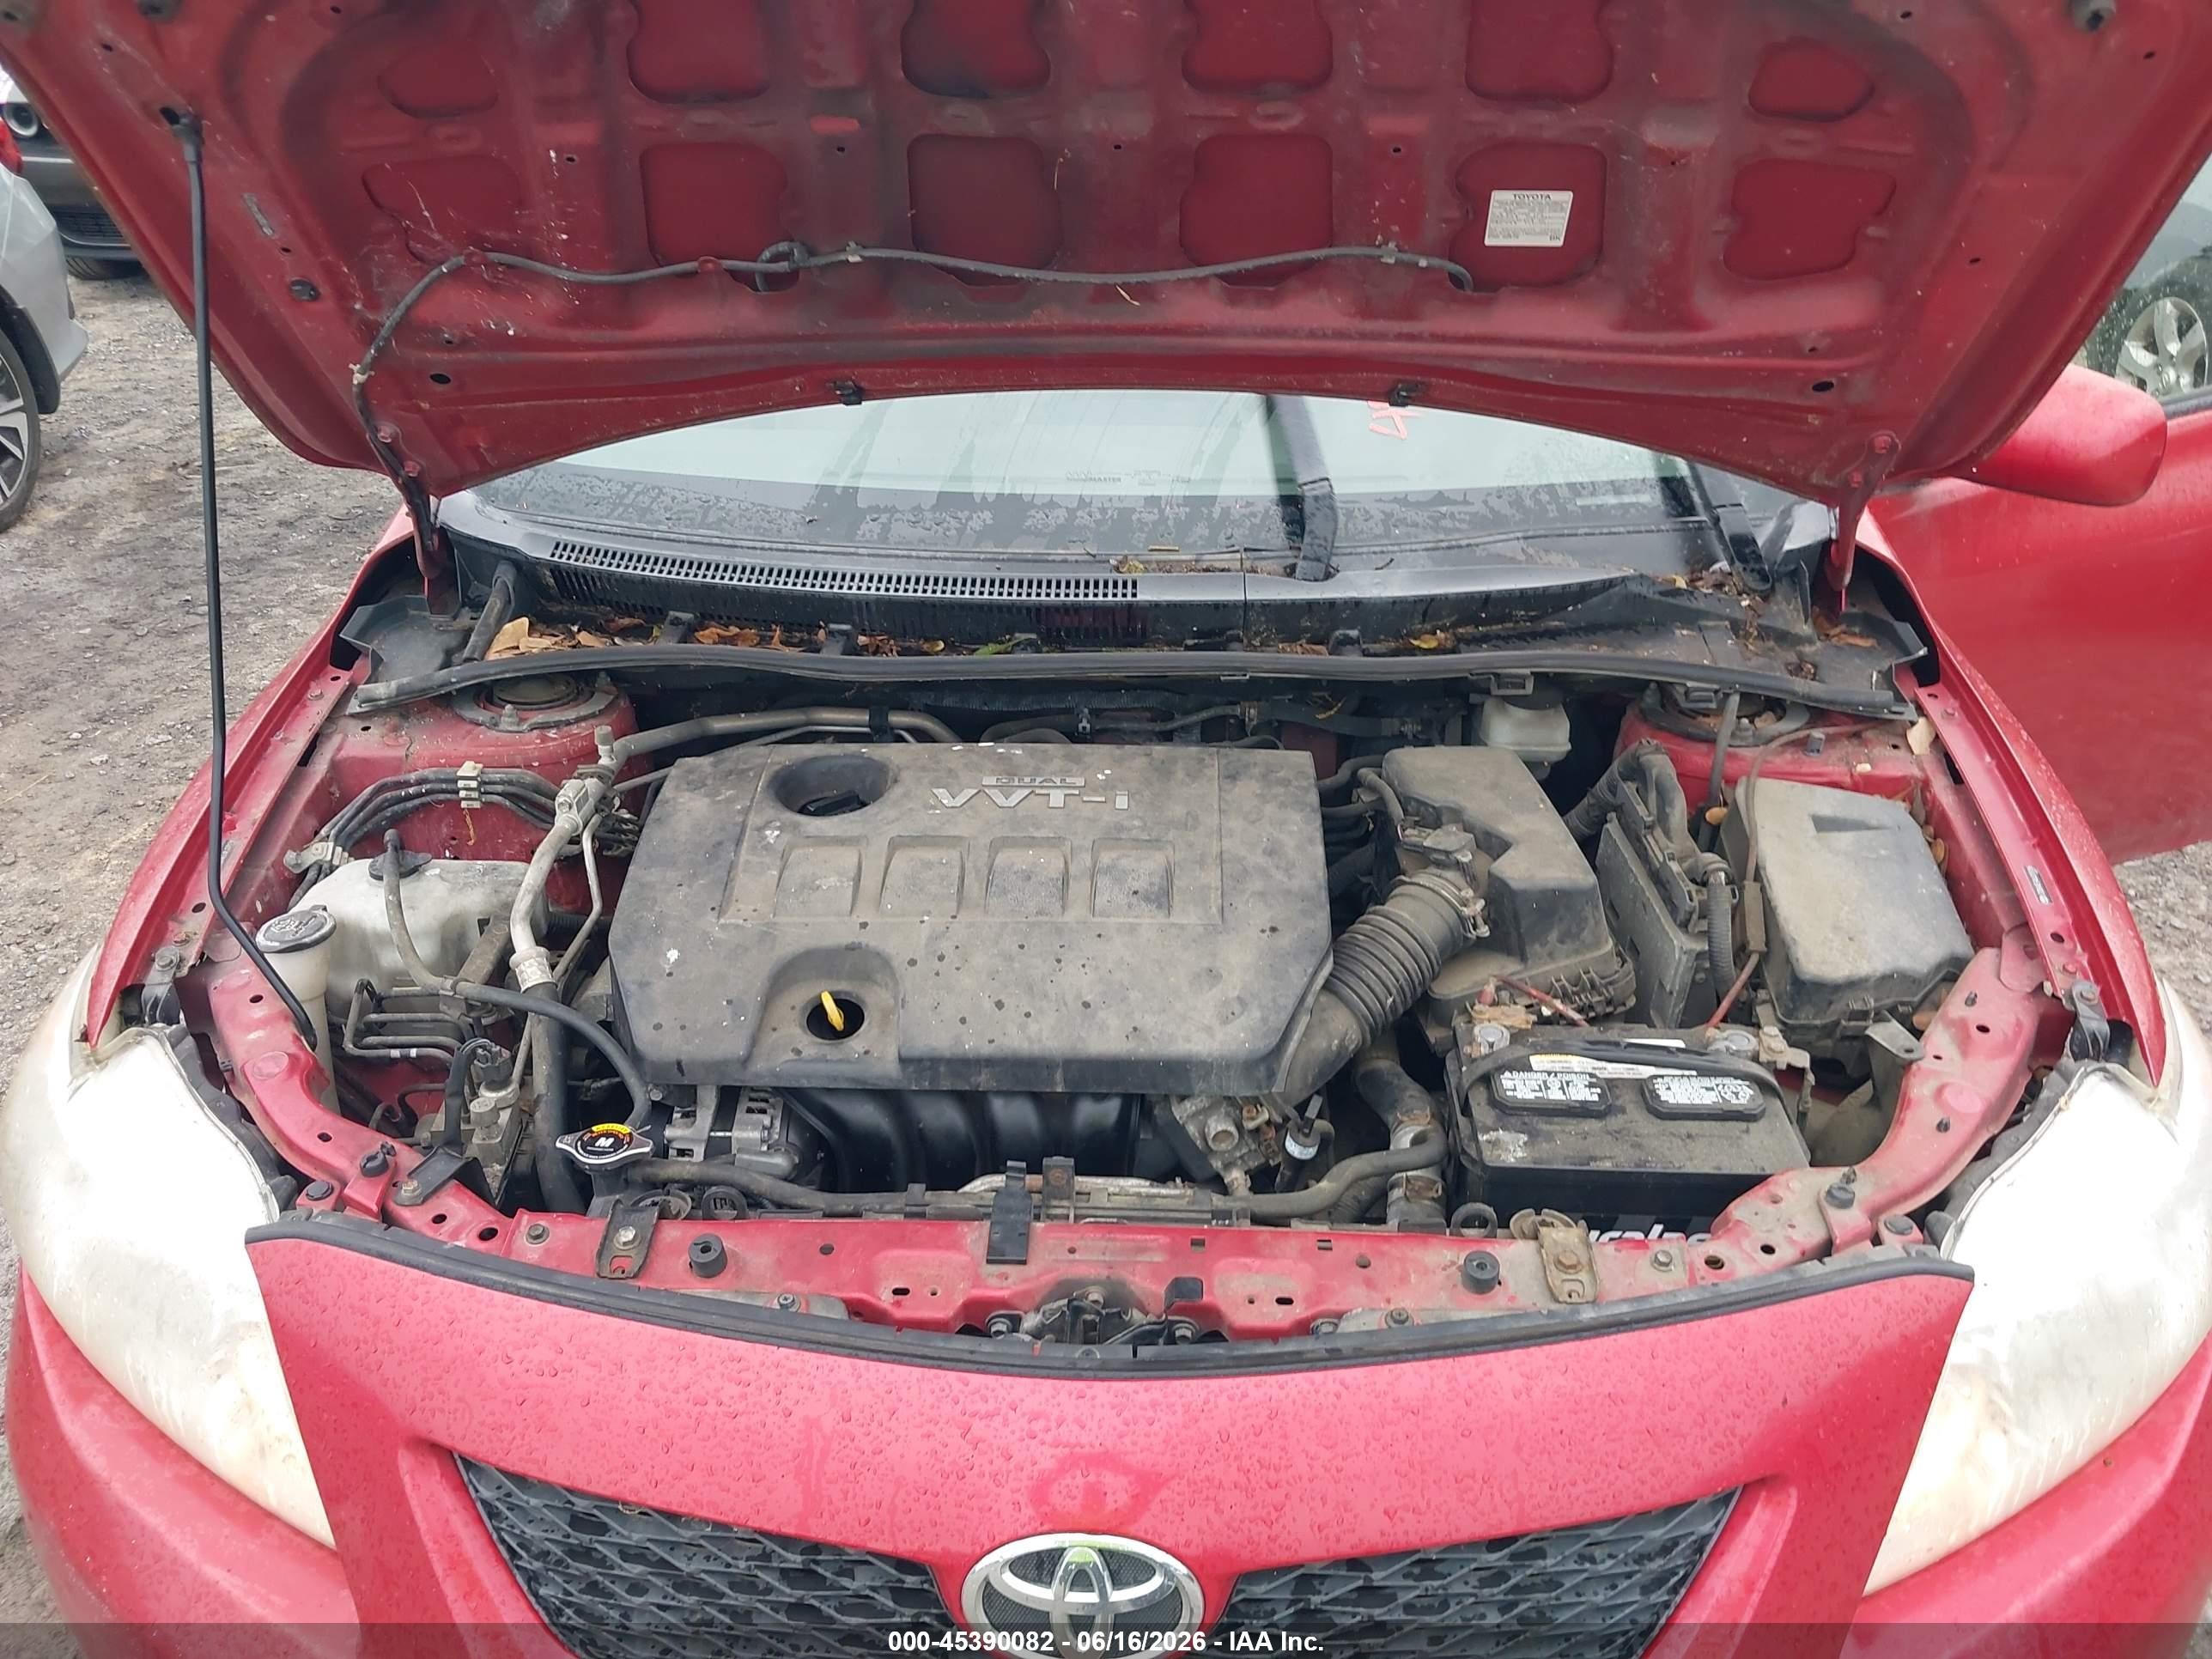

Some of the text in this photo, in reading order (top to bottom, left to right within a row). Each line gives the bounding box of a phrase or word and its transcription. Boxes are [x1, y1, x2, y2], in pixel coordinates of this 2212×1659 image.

[994, 776, 1078, 785] DUAL
[932, 788, 1129, 810] VVT-i
[1512, 1070, 1549, 1080] DANGER
[1557, 1072, 1590, 1080] POISON
